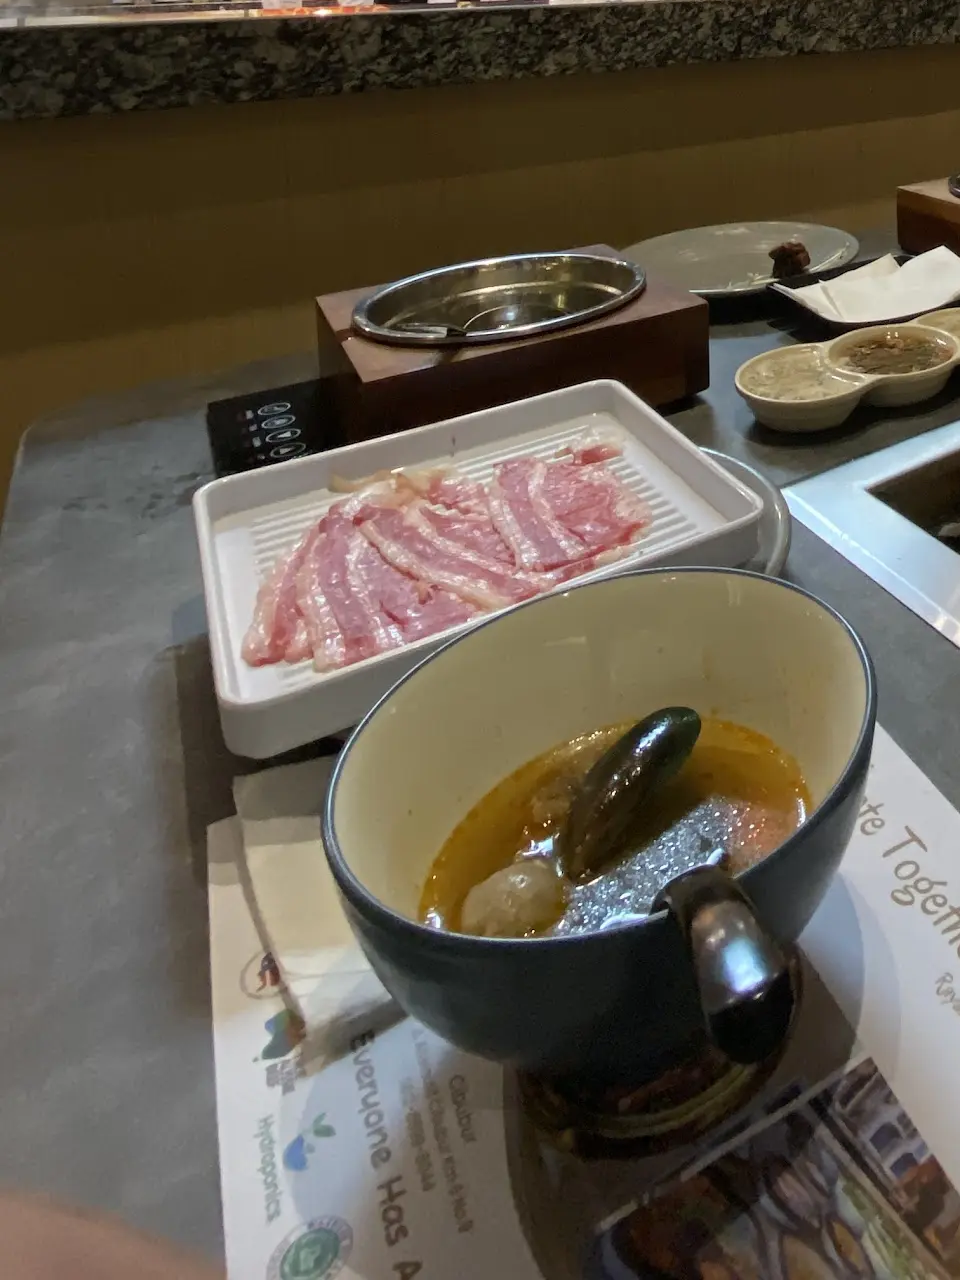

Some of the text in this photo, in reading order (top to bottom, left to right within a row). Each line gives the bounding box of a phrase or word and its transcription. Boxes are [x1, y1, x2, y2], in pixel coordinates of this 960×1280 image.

[253, 1114, 283, 1227] Hydroponics
[351, 1029, 392, 1171] Everyone
[376, 1175, 410, 1247] Has
